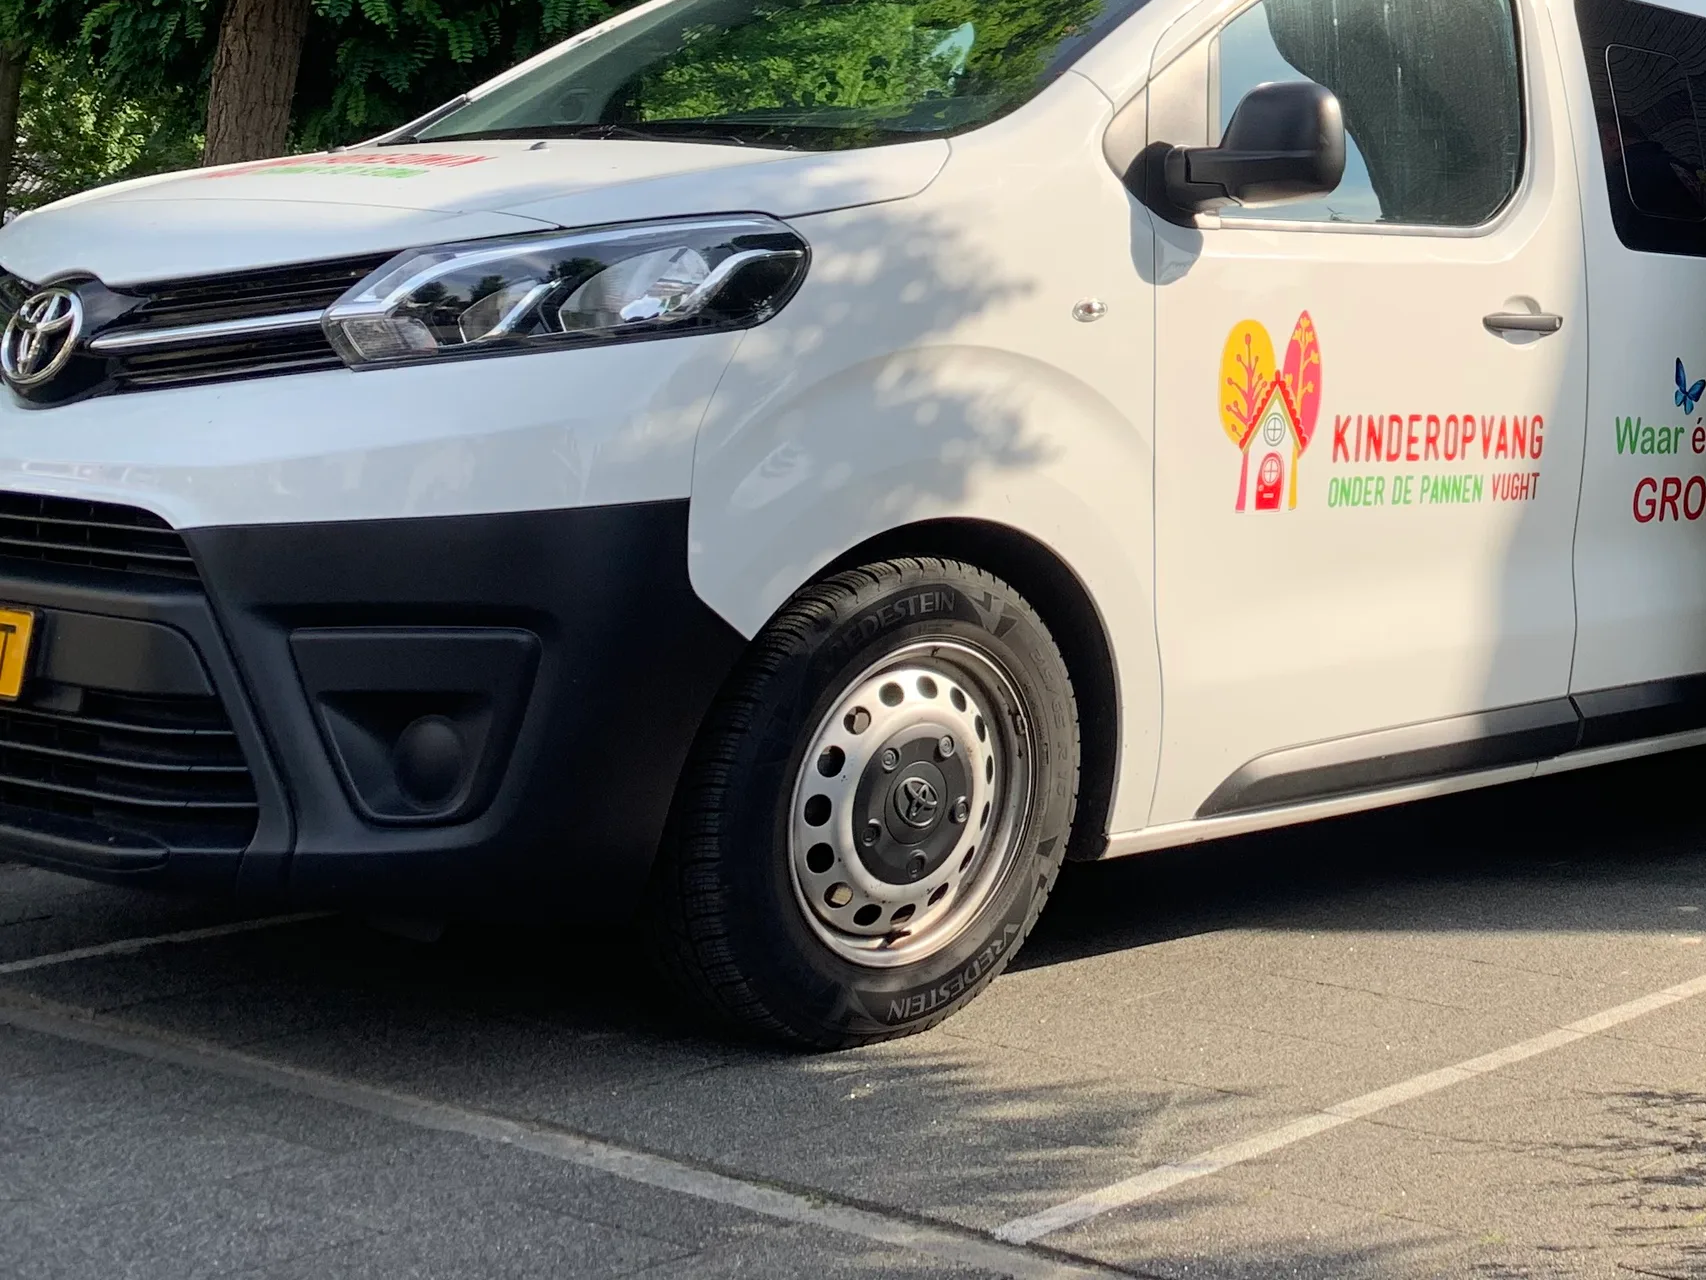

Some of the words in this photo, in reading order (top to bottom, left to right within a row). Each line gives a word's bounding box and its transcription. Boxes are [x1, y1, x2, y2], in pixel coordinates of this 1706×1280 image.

[1331, 413, 1545, 463] KINDEROPVANG
[1615, 416, 1685, 455] Waar
[1327, 476, 1386, 508] ONDER
[1391, 475, 1414, 505] DE
[1419, 474, 1484, 504] PANNEN
[1492, 472, 1540, 502] VUGHT
